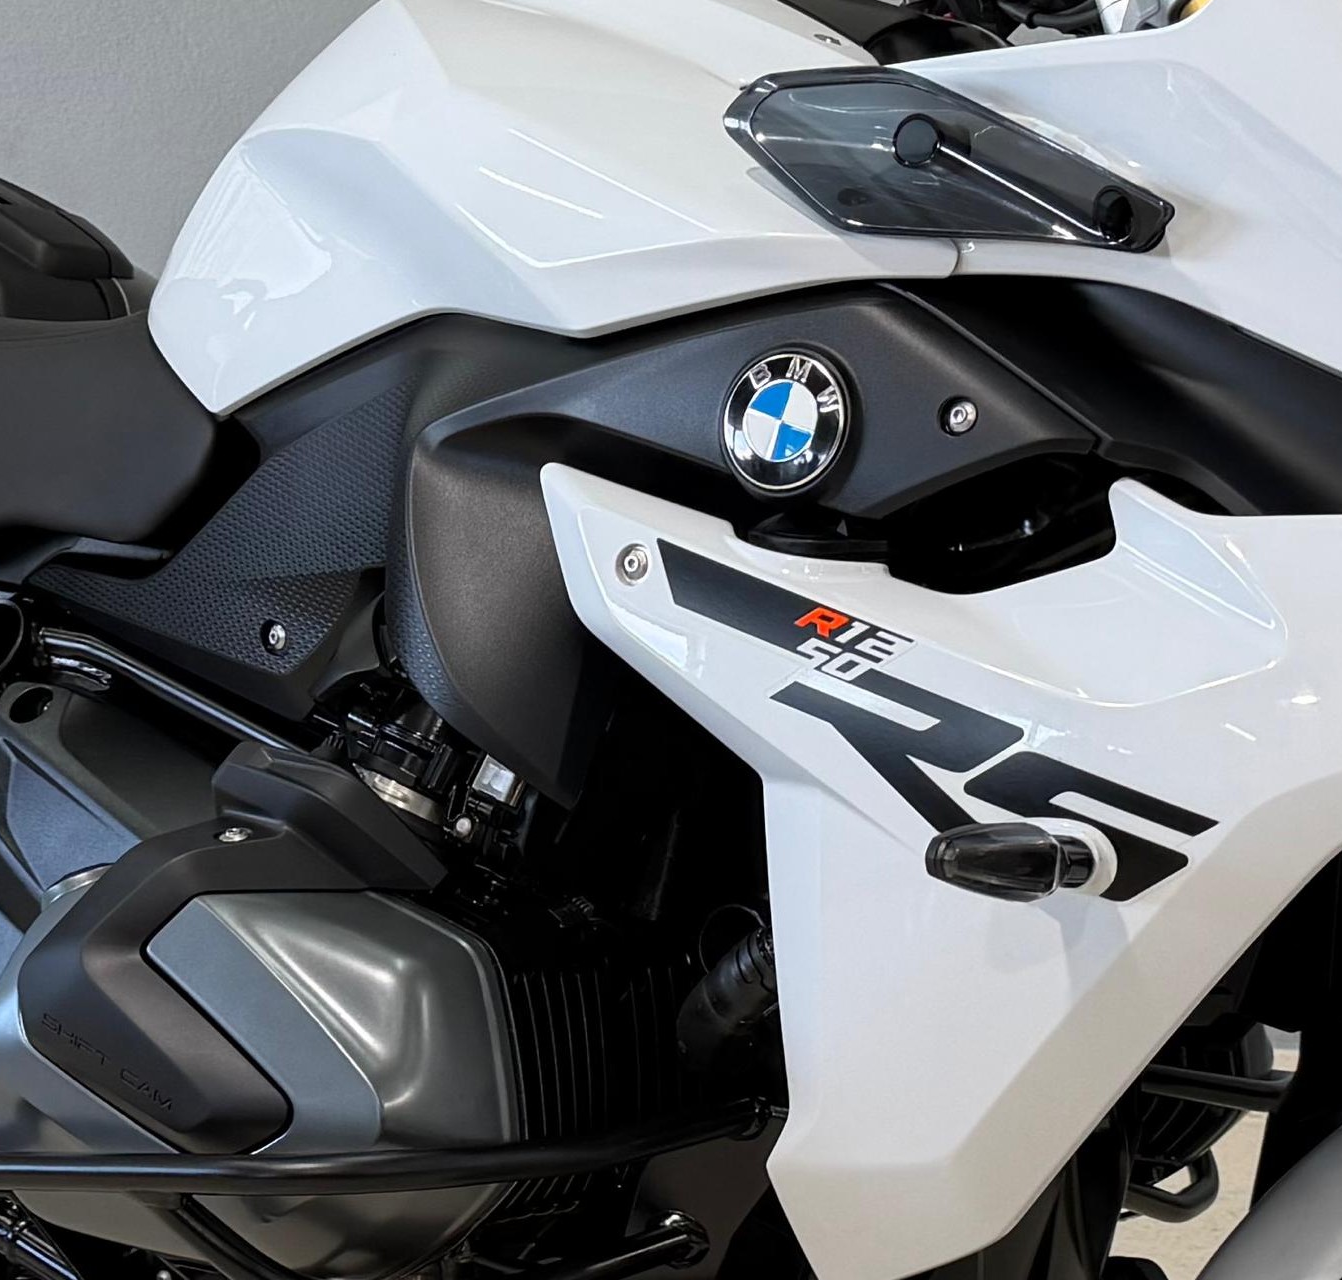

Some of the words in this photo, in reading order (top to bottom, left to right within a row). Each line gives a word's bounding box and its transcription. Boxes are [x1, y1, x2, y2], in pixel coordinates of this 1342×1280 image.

[749, 356, 839, 413] BMW
[41, 1012, 110, 1065] SHIFT
[120, 1068, 173, 1110] CAM
